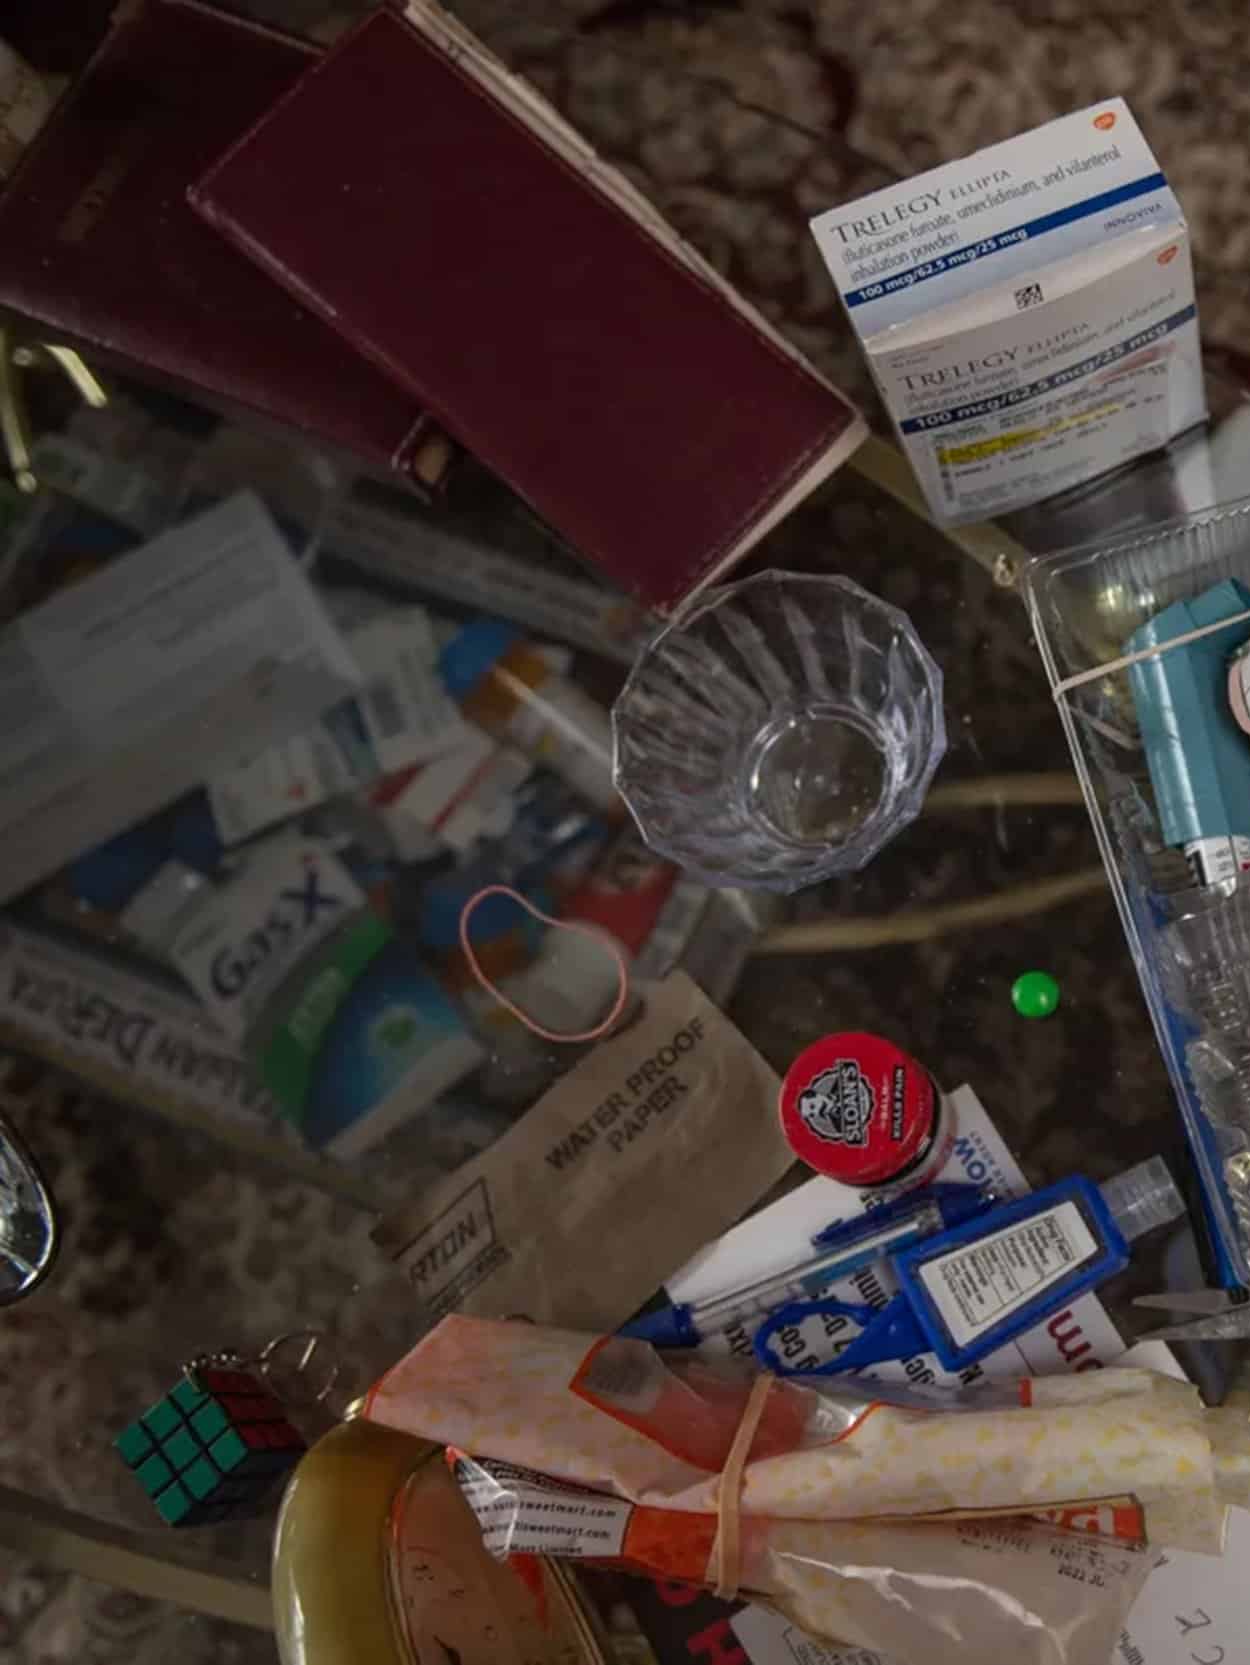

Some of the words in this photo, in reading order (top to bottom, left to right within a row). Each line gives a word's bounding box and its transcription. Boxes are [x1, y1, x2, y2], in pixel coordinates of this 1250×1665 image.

[1041, 165, 1066, 188] and
[1066, 146, 1121, 179] vilanterol
[829, 189, 943, 245] TRELEGY
[950, 168, 1011, 201] ELLIPTA
[1104, 203, 1163, 232] INNOVIVA
[858, 285, 884, 302] 100
[885, 257, 947, 295] mcg/62.5
[947, 237, 998, 269] mcg/25
[999, 229, 1029, 248] mcg
[897, 343, 1019, 391] TRELEGY
[916, 412, 953, 430] 100
[1128, 323, 1169, 350] mcg
[545, 1090, 629, 1171] WATER
[625, 1016, 706, 1099] PROOF
[606, 1073, 690, 1153] PAPER
[839, 1063, 862, 1145] SLOAN'S
[894, 1067, 905, 1097] PAIN
[892, 1101, 903, 1139] KILLS
